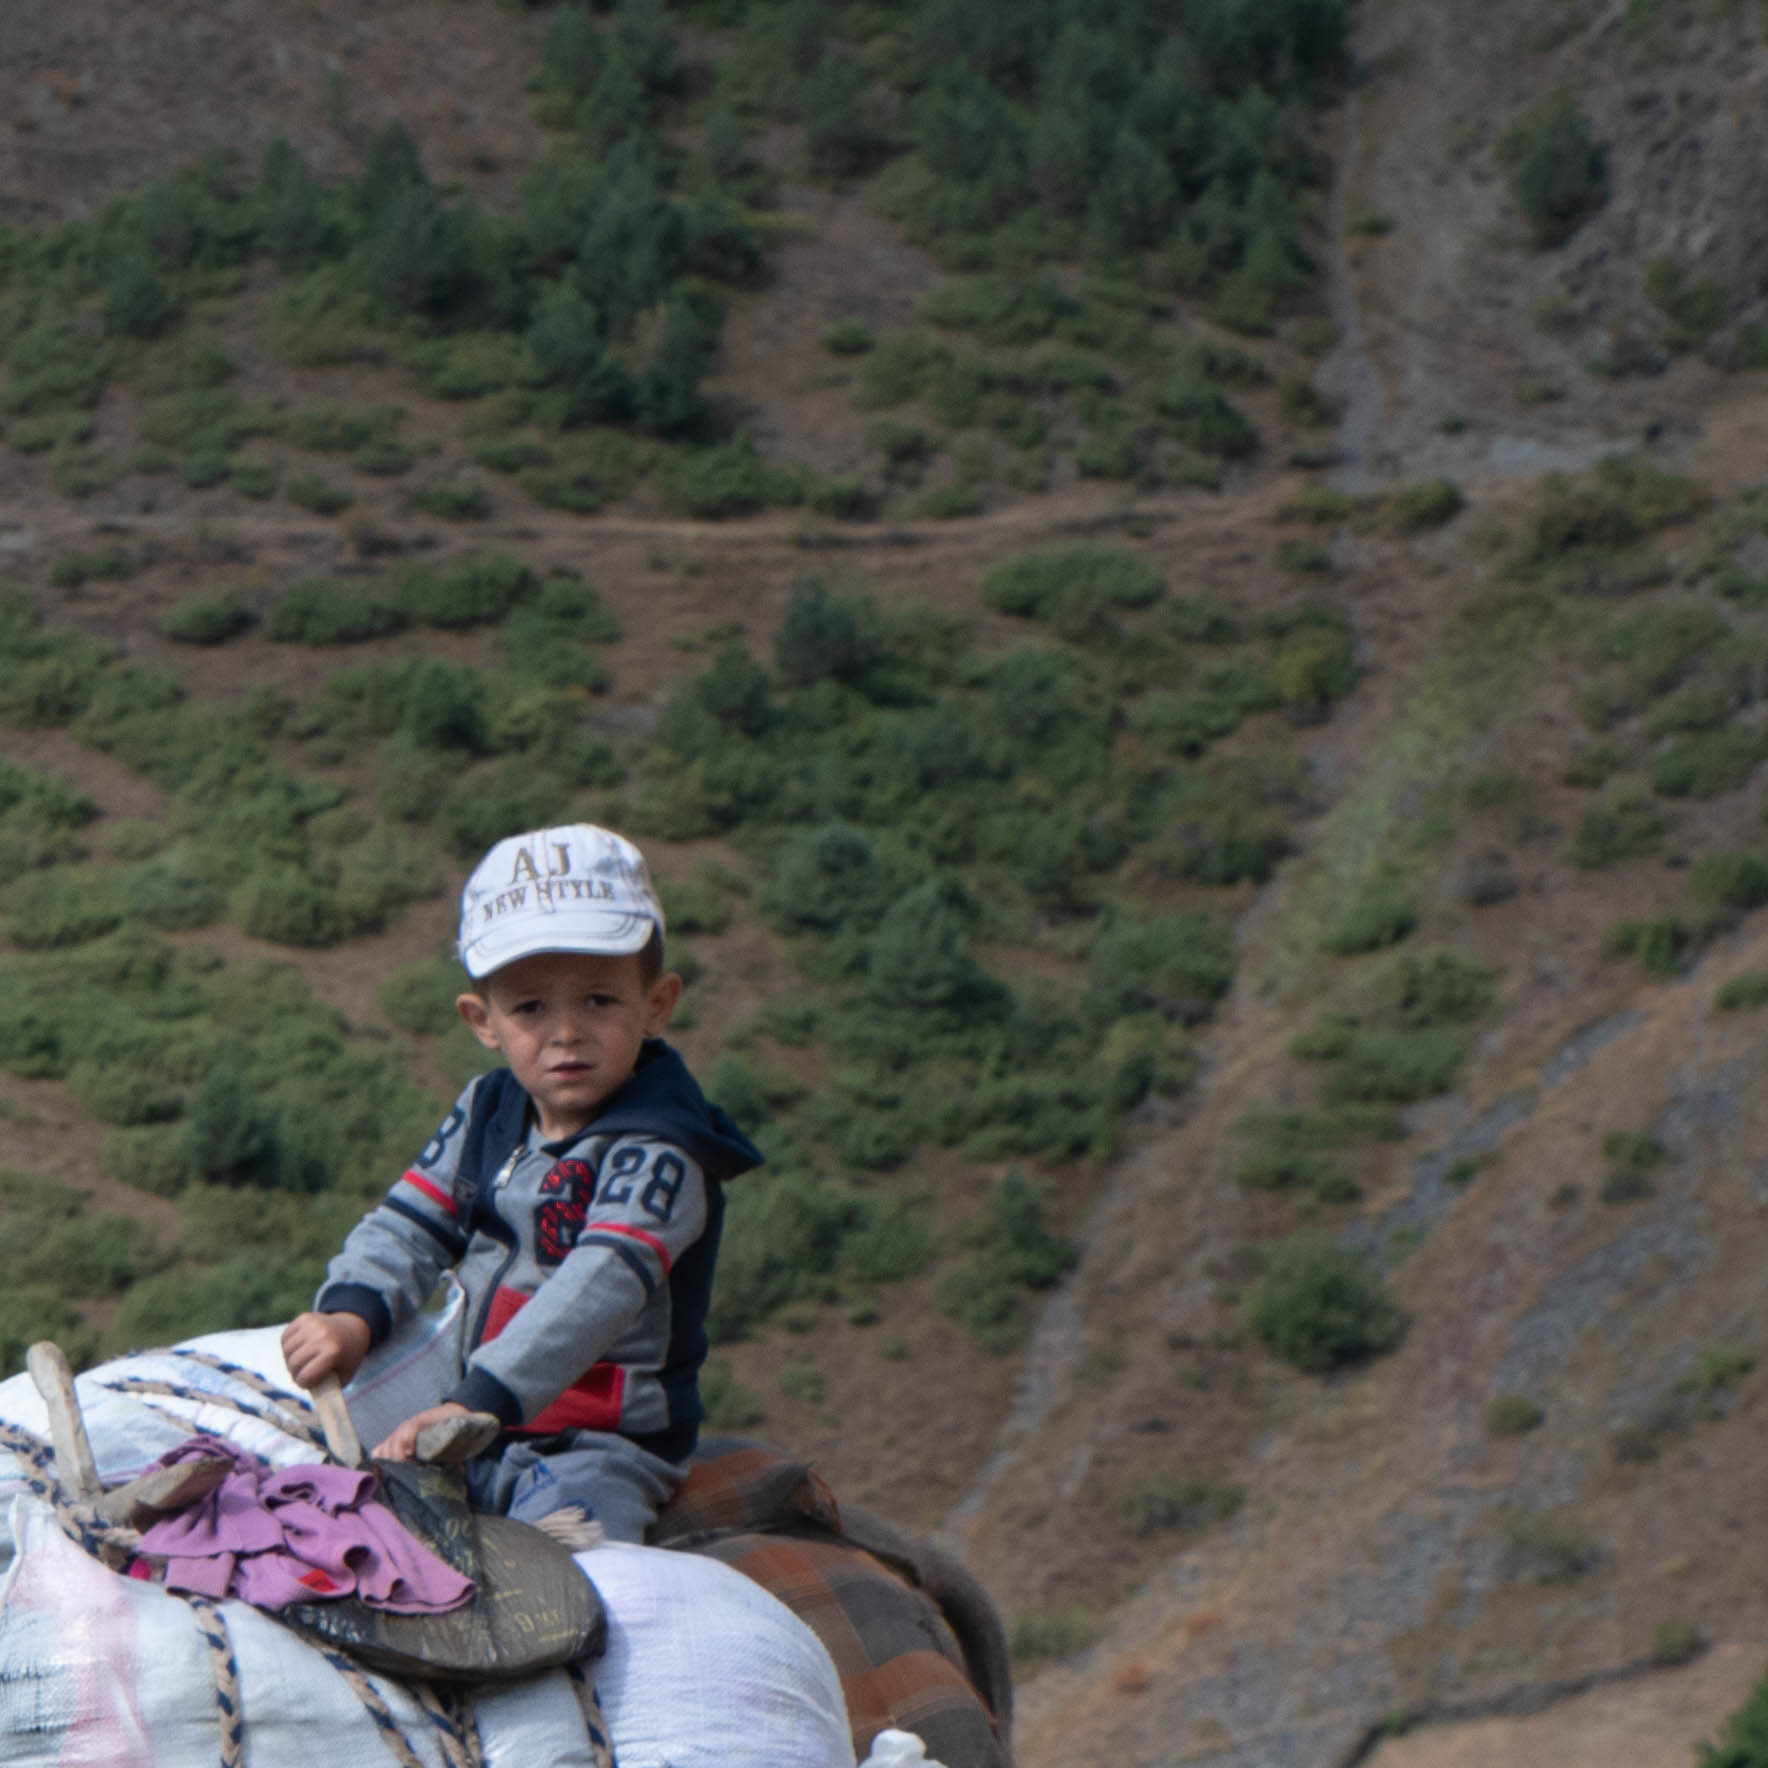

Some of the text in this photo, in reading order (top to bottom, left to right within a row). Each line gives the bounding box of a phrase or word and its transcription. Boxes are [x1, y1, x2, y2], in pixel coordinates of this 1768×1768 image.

[507, 842, 572, 886] AJ
[482, 885, 527, 920] NEW
[595, 1145, 686, 1223] 28
